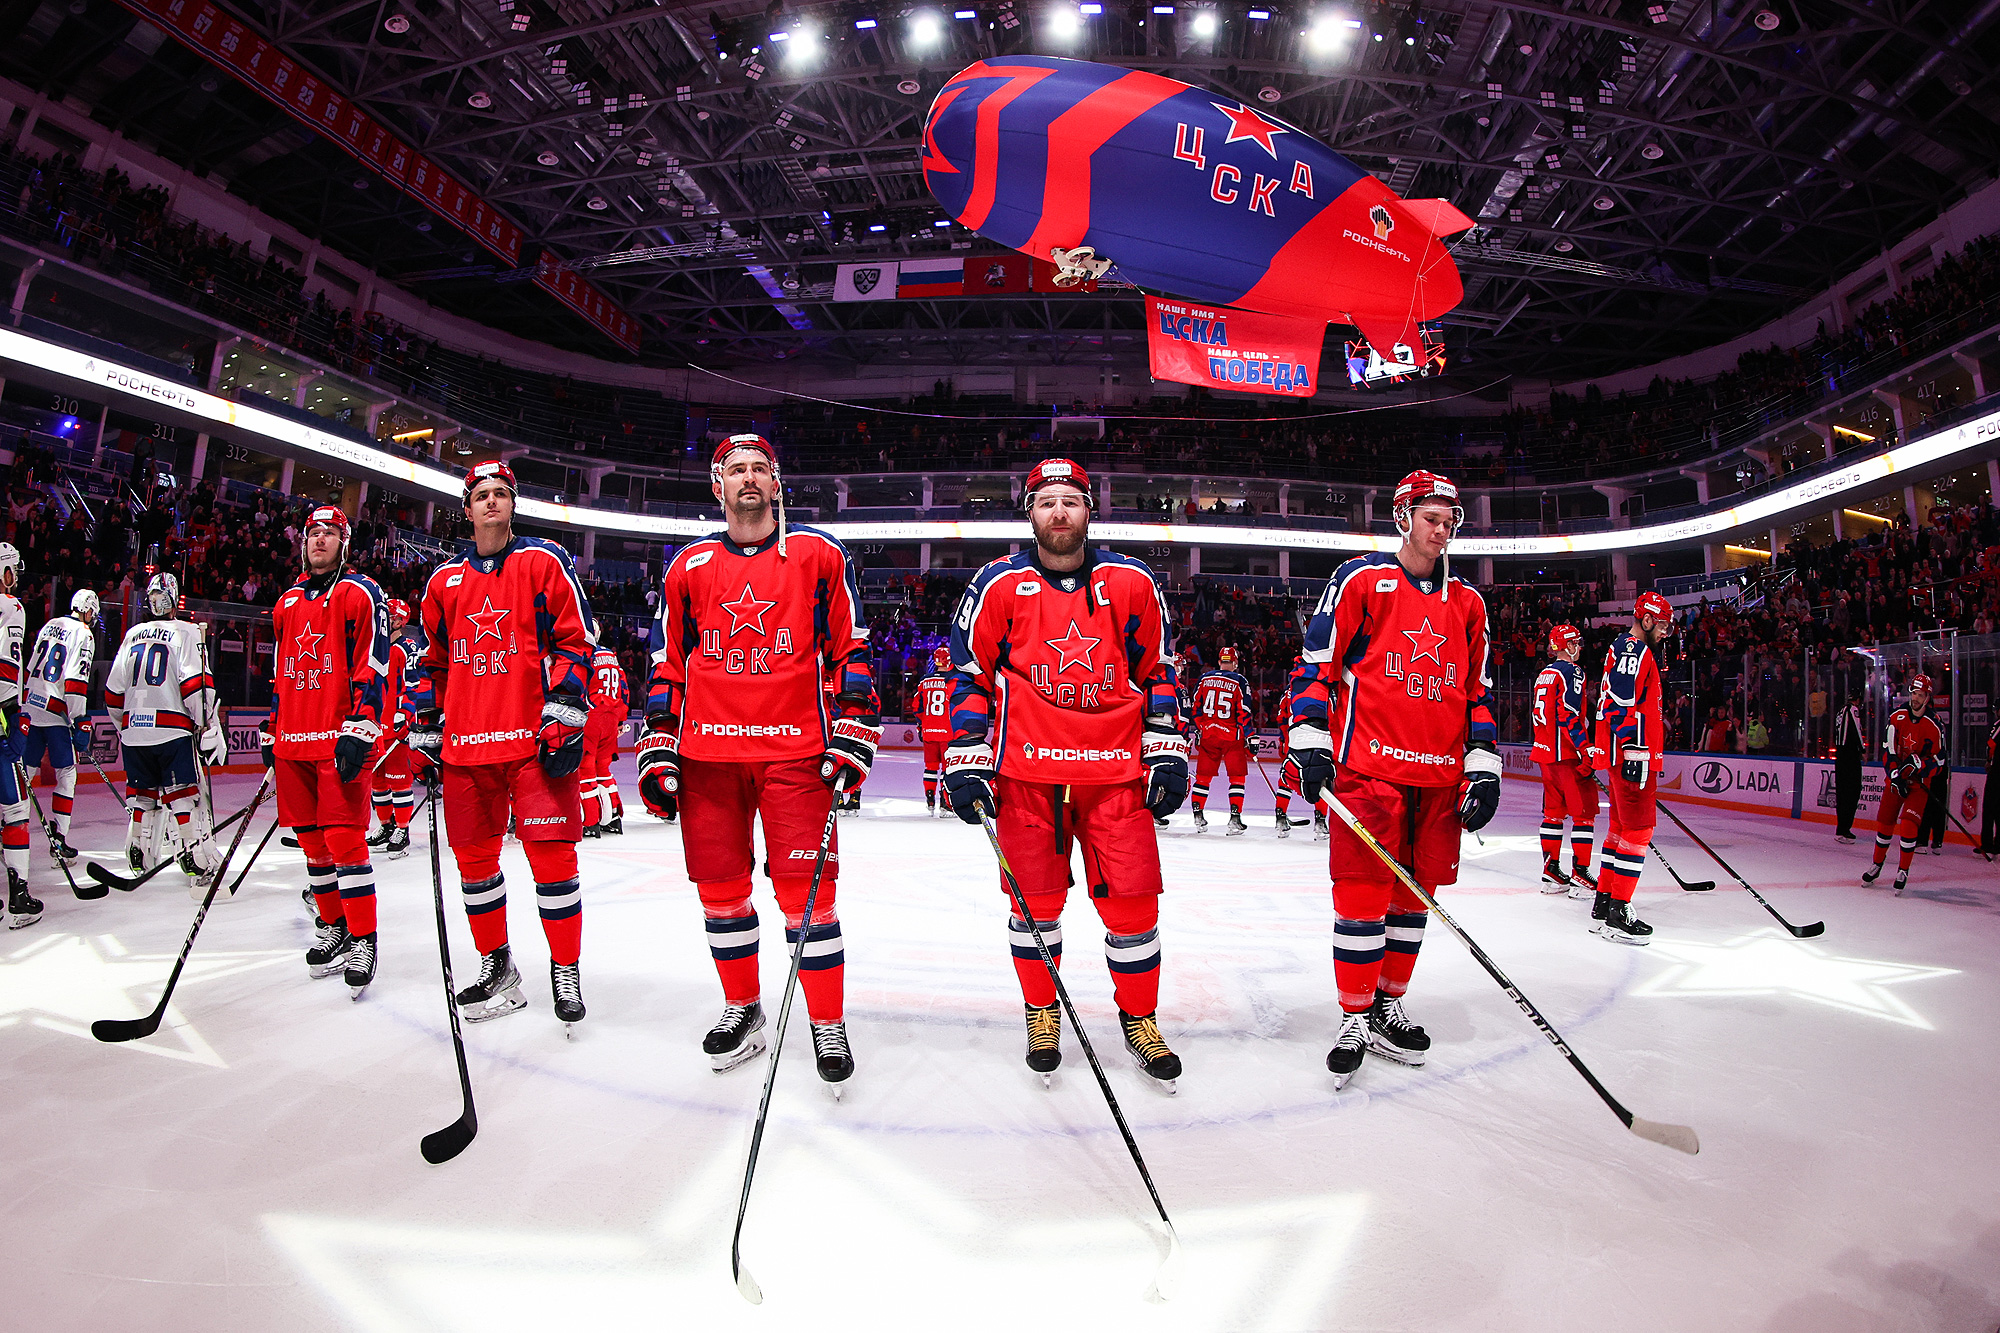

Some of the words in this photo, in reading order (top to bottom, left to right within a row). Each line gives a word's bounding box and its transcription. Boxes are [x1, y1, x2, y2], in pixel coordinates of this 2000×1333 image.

[193, 13, 213, 35] 67
[220, 31, 240, 53] 26
[250, 52, 262, 68] 4
[274, 67, 289, 88] 12
[297, 85, 315, 106] 23
[324, 102, 339, 121] 13
[349, 119, 360, 137] 11
[372, 137, 381, 153] 3
[392, 152, 406, 171] 21
[1173, 122, 1314, 218] ЦСКА
[415, 167, 427, 185] 15
[436, 183, 444, 198] 2
[489, 222, 501, 240] 24
[508, 237, 516, 251] 4
[1343, 229, 1411, 263] РОСНЕФТЬ
[1156, 302, 1187, 315] НАШЕ
[1191, 308, 1215, 319] ИМЯ
[1160, 311, 1228, 347] ЦСКА
[1207, 347, 1239, 358] НАША
[1243, 351, 1269, 361] ЦЕЛЬ
[1208, 356, 1311, 392] ПОБЕДА
[106, 369, 195, 408] РОСНЕФТЬ
[1917, 380, 1936, 400] 417
[50, 395, 79, 416] 310
[1860, 406, 1879, 423] 416
[391, 413, 409, 429] 405
[151, 423, 175, 443] 311
[225, 444, 249, 463] 312
[320, 437, 386, 469] РОСНЕФТЬ
[1782, 443, 1798, 457] 415
[325, 473, 345, 490] 313
[803, 484, 821, 493] 409
[936, 483, 969, 493] Lounge
[1799, 473, 1861, 500] РОСНЕФТЬ
[1933, 475, 1953, 494] 324
[381, 490, 399, 505] 314
[1325, 493, 1347, 504] 412
[445, 510, 462, 523] 315
[1790, 521, 1806, 537] 322
[863, 544, 885, 555] 317
[1148, 546, 1171, 557] 319
[1463, 543, 1537, 551] РОСНЕФТЬ
[1021, 584, 1035, 592] МИР
[258, 644, 273, 652] сога
[453, 631, 518, 677] ЦСКА
[702, 627, 794, 675] ЦСКА
[31, 640, 67, 683] 28
[129, 642, 170, 687] 70
[1616, 656, 1638, 675] 48
[283, 653, 333, 690] ЦСКА
[1385, 651, 1458, 702] ЦСКА
[597, 667, 620, 700] 39
[922, 680, 948, 689] MAKARO
[1030, 664, 1116, 708] ЦСКА
[925, 690, 945, 716] 18
[1202, 689, 1234, 719] 45
[284, 730, 341, 742] РОСНЕФТЬ
[342, 725, 376, 740] CCM
[460, 728, 533, 746] РОСНЕФТЬ
[702, 723, 801, 737] РОСНЕФТЬ
[1038, 747, 1132, 762] РОСНЕФТЬ
[1382, 745, 1456, 766] РОСНЕФТЬ
[1737, 770, 1781, 794] LADA
[1862, 775, 1878, 783] НБЕТ
[1862, 784, 1885, 793] НТИНЕН
[1861, 793, 1881, 802] ККЕЙН
[524, 816, 568, 826] BAUER
[820, 810, 836, 850] CCM
[1571, 874, 1595, 889] CCM
[799, 898, 813, 941] RIBCOR
[1436, 904, 1461, 931] BAUER
[179, 904, 207, 964] CCM
[1033, 935, 1053, 968] BAUER
[1504, 986, 1573, 1059] BAUER
